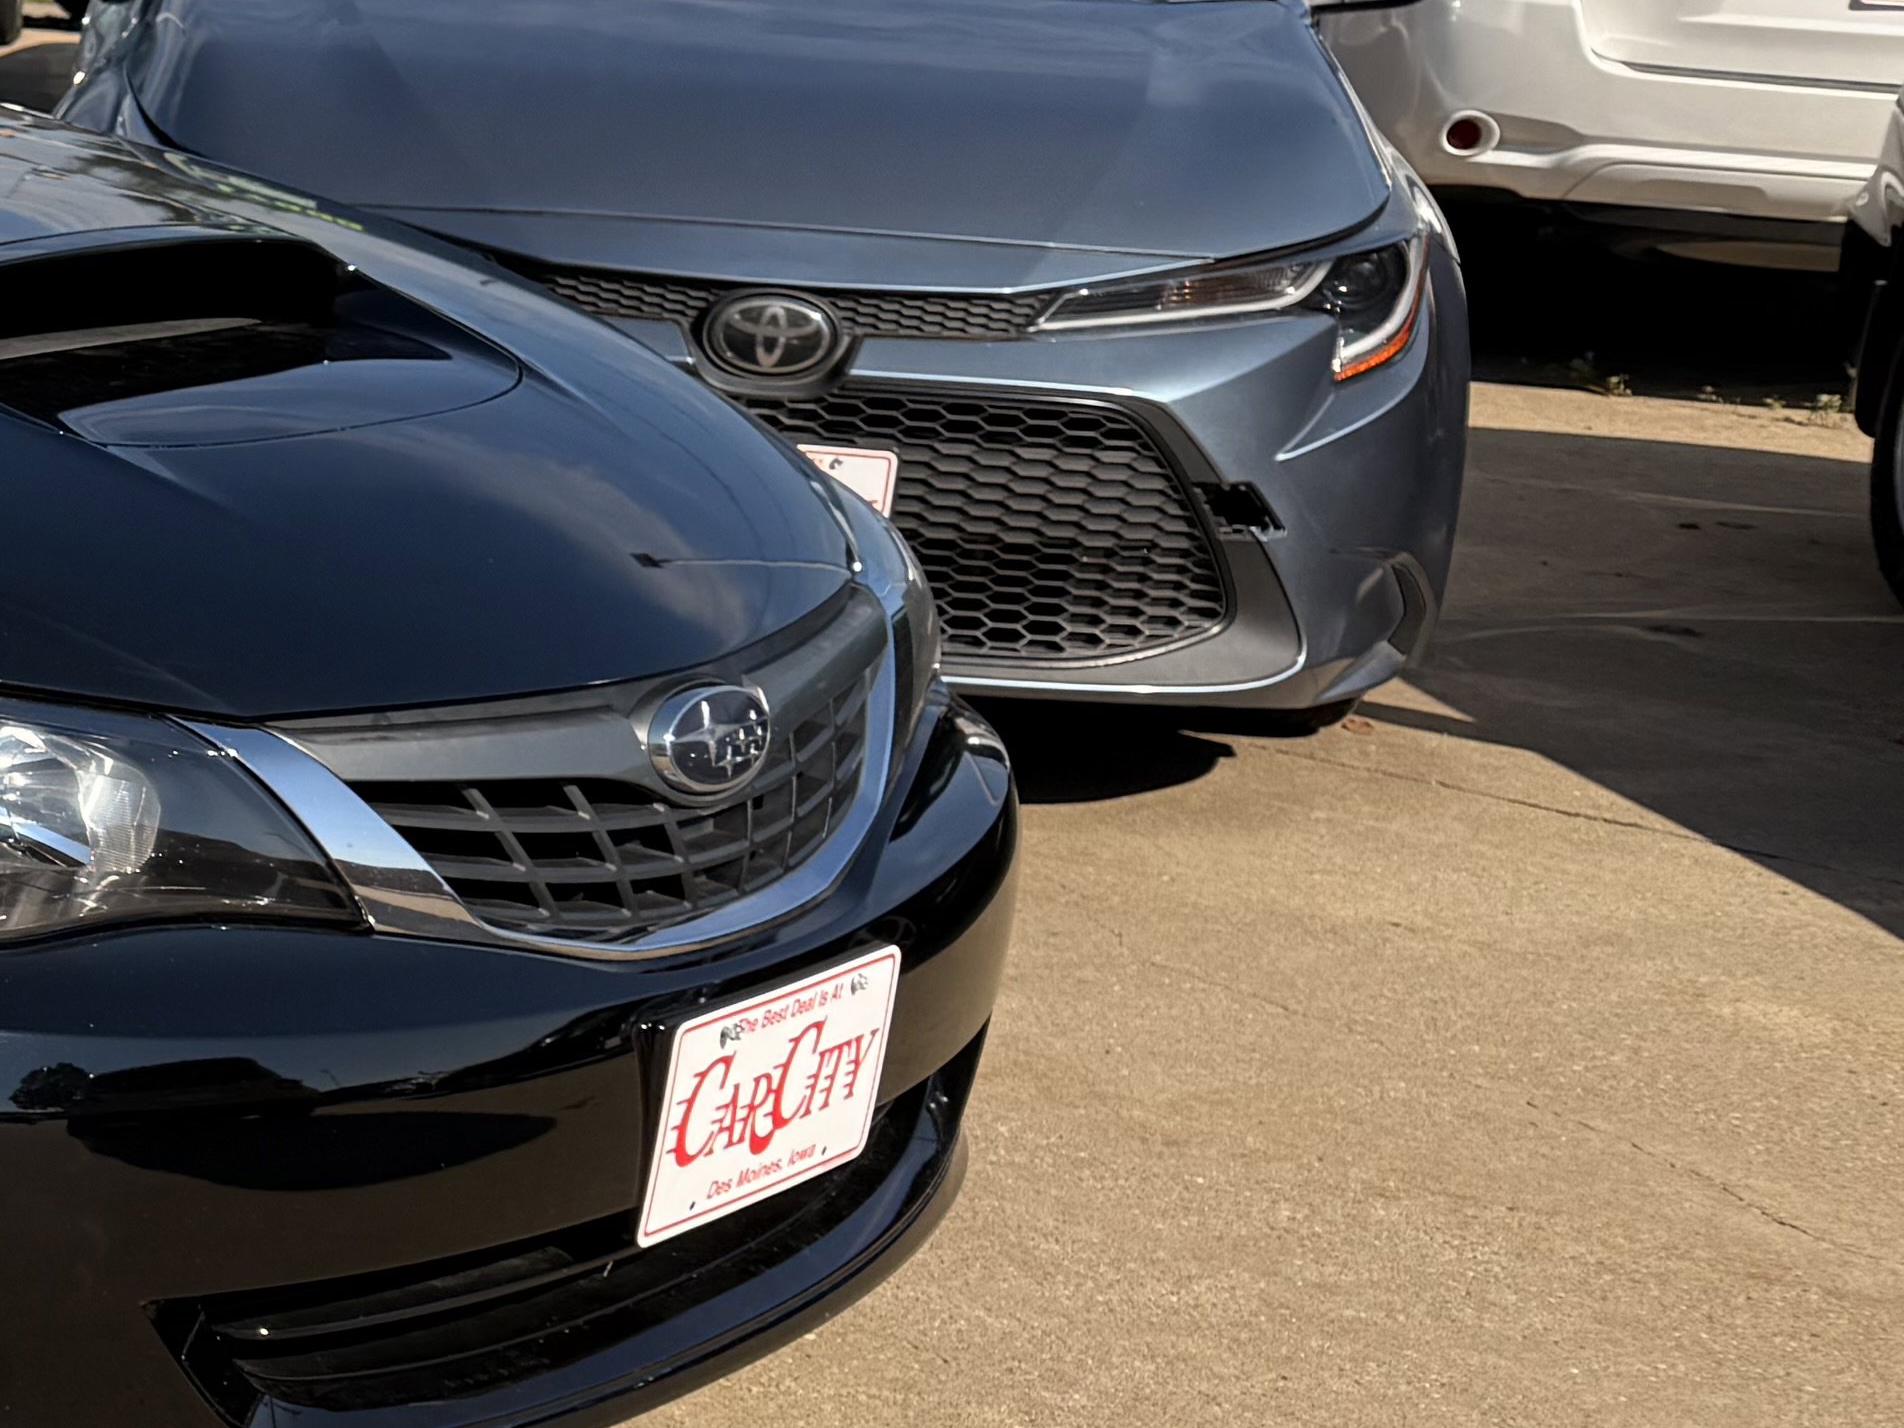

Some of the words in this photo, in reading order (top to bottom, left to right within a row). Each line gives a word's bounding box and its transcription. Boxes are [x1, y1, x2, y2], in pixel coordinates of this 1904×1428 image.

[760, 1002, 789, 1030] Best
[791, 991, 818, 1018] Deal
[817, 988, 831, 1009] Is
[830, 982, 845, 1004] At
[706, 1175, 733, 1201] Des
[787, 1143, 817, 1168] Iowa
